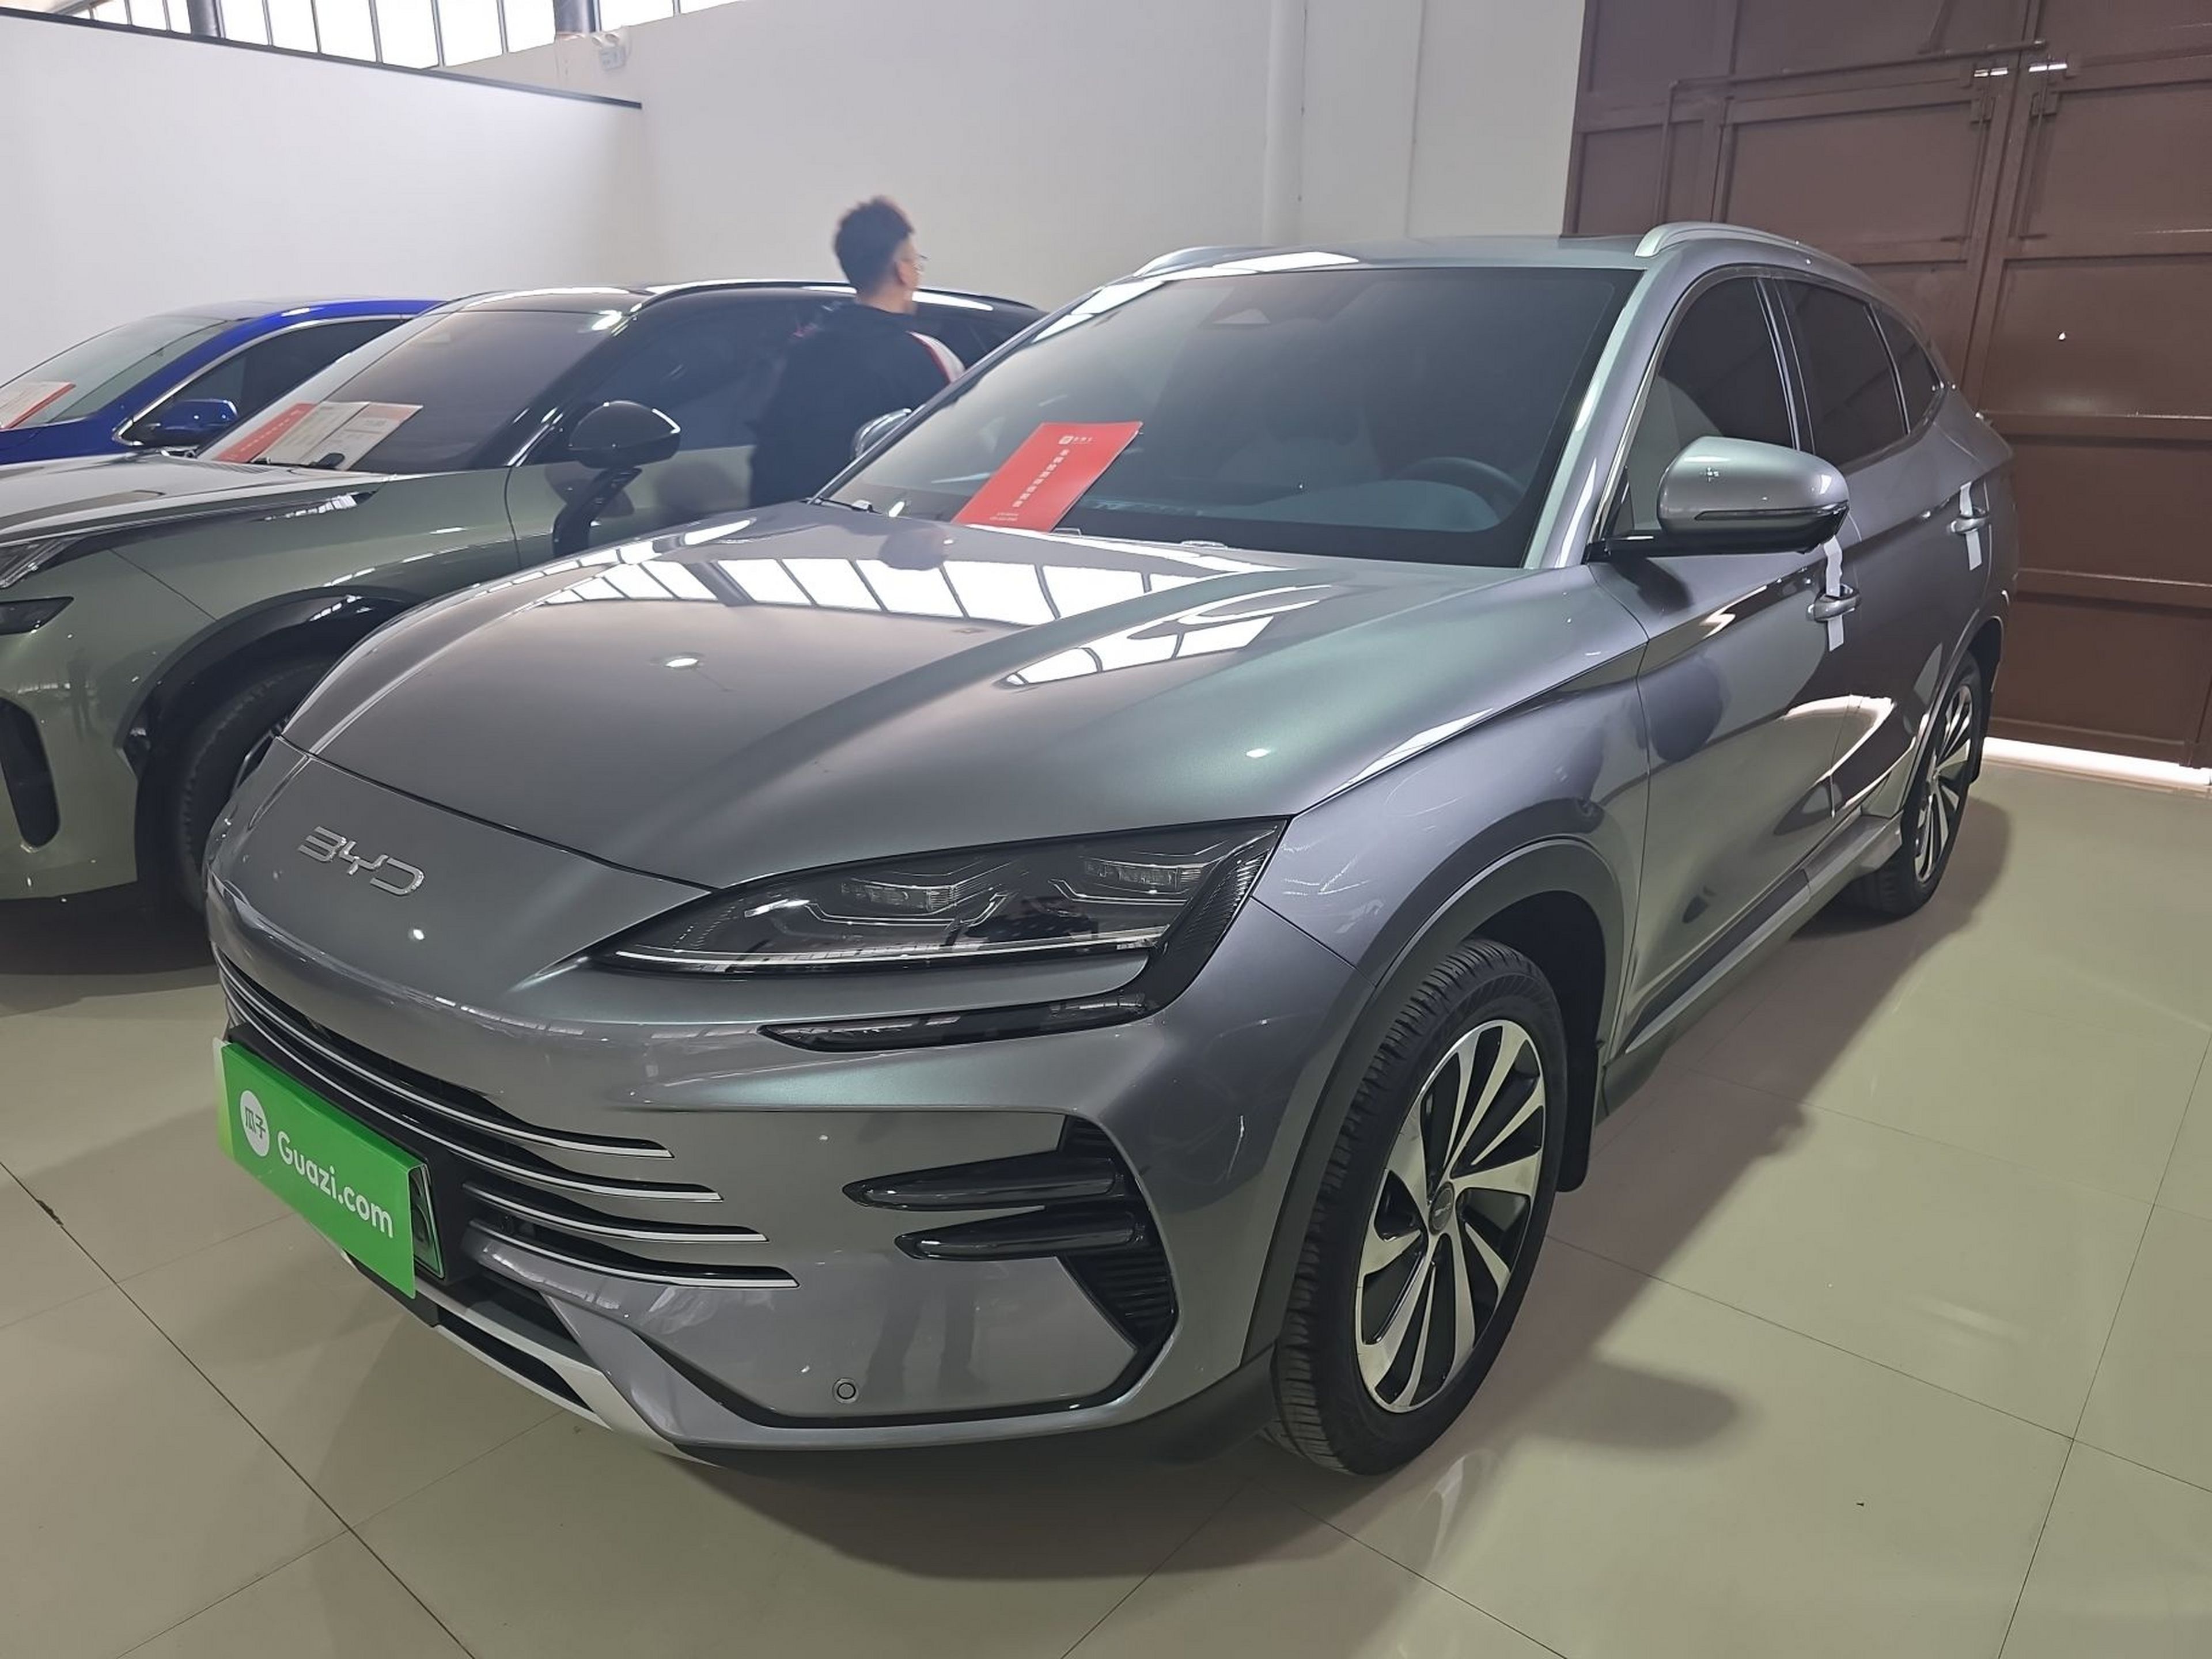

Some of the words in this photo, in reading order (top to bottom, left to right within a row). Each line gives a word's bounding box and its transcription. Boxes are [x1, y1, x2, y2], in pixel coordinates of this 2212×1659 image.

[298, 826, 425, 896] BYD
[244, 1107, 266, 1139] 瓜子
[277, 1131, 394, 1238] Guazi.com
